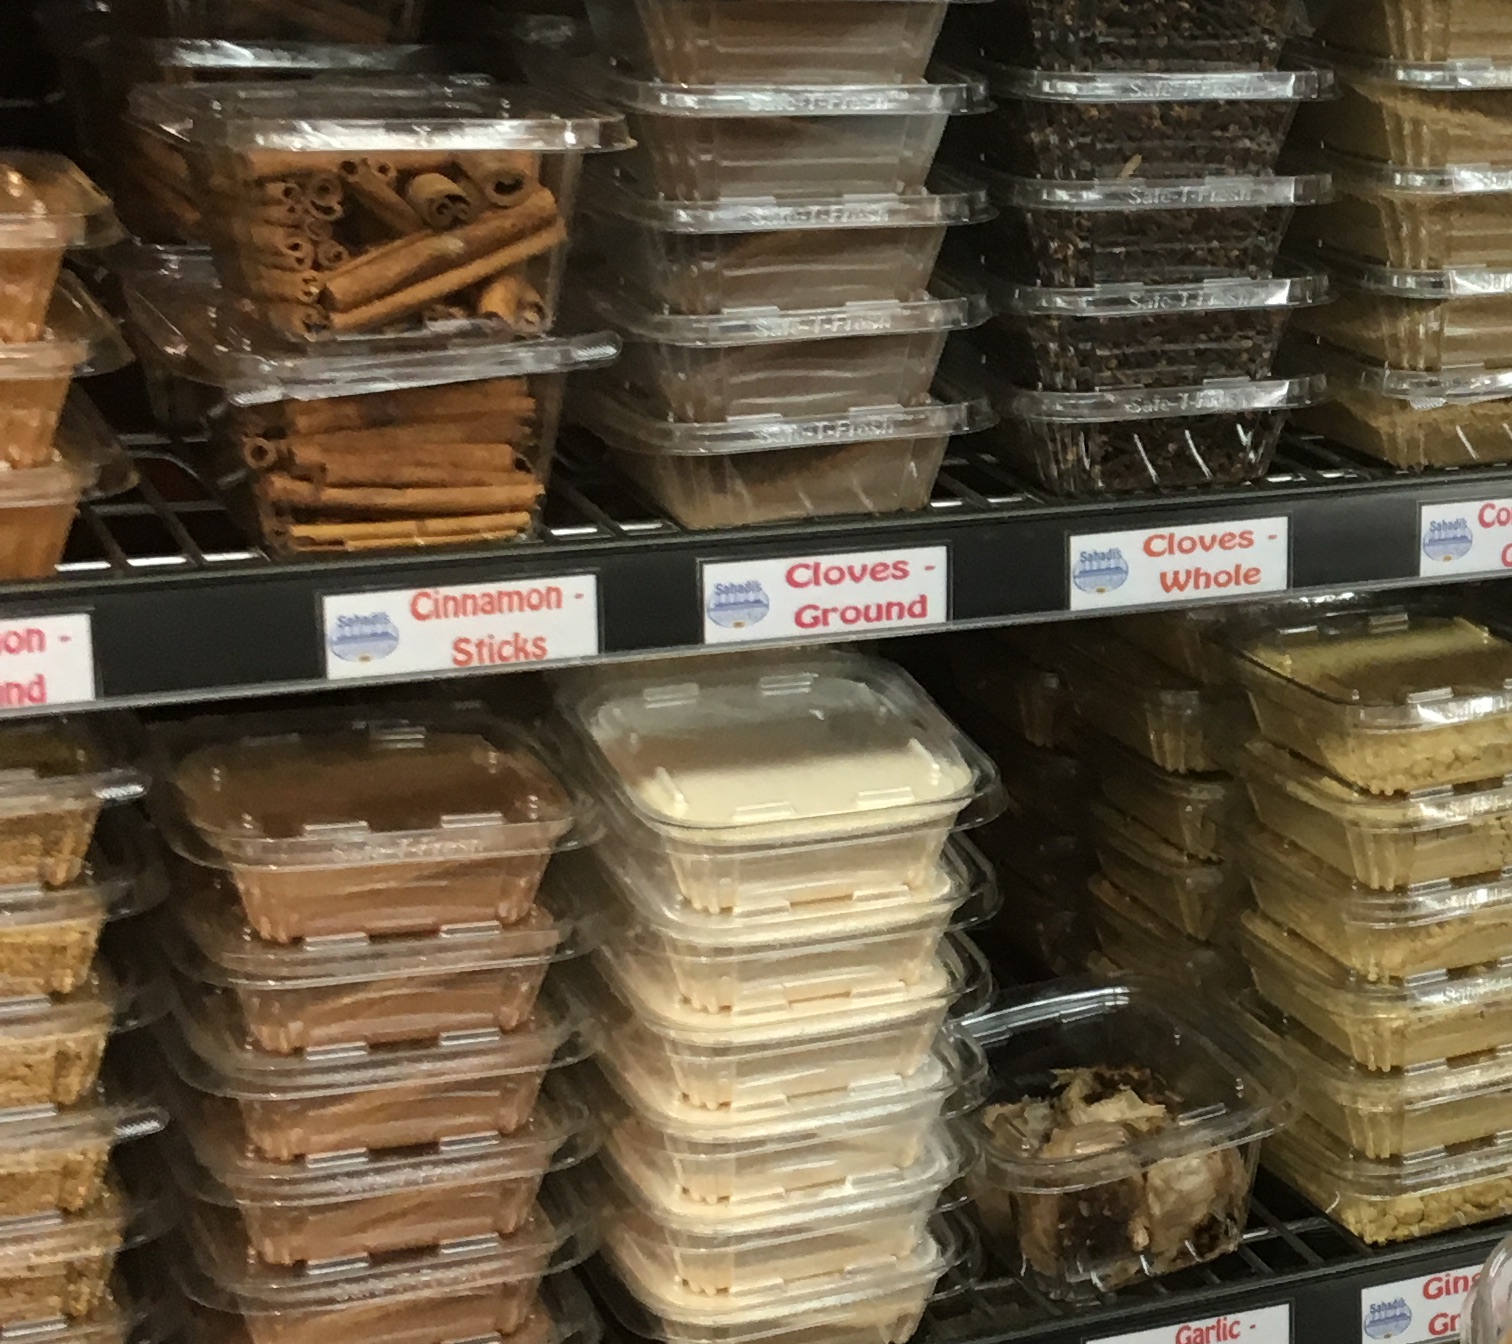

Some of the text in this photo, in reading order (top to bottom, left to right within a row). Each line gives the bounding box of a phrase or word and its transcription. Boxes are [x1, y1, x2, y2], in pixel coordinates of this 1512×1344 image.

[1142, 529, 1255, 557] Cloves
[785, 559, 910, 590] Cloves
[1159, 564, 1262, 594] Whole
[410, 583, 563, 622] Cinnamon
[793, 595, 928, 629] Ground
[451, 632, 548, 668] Sticks
